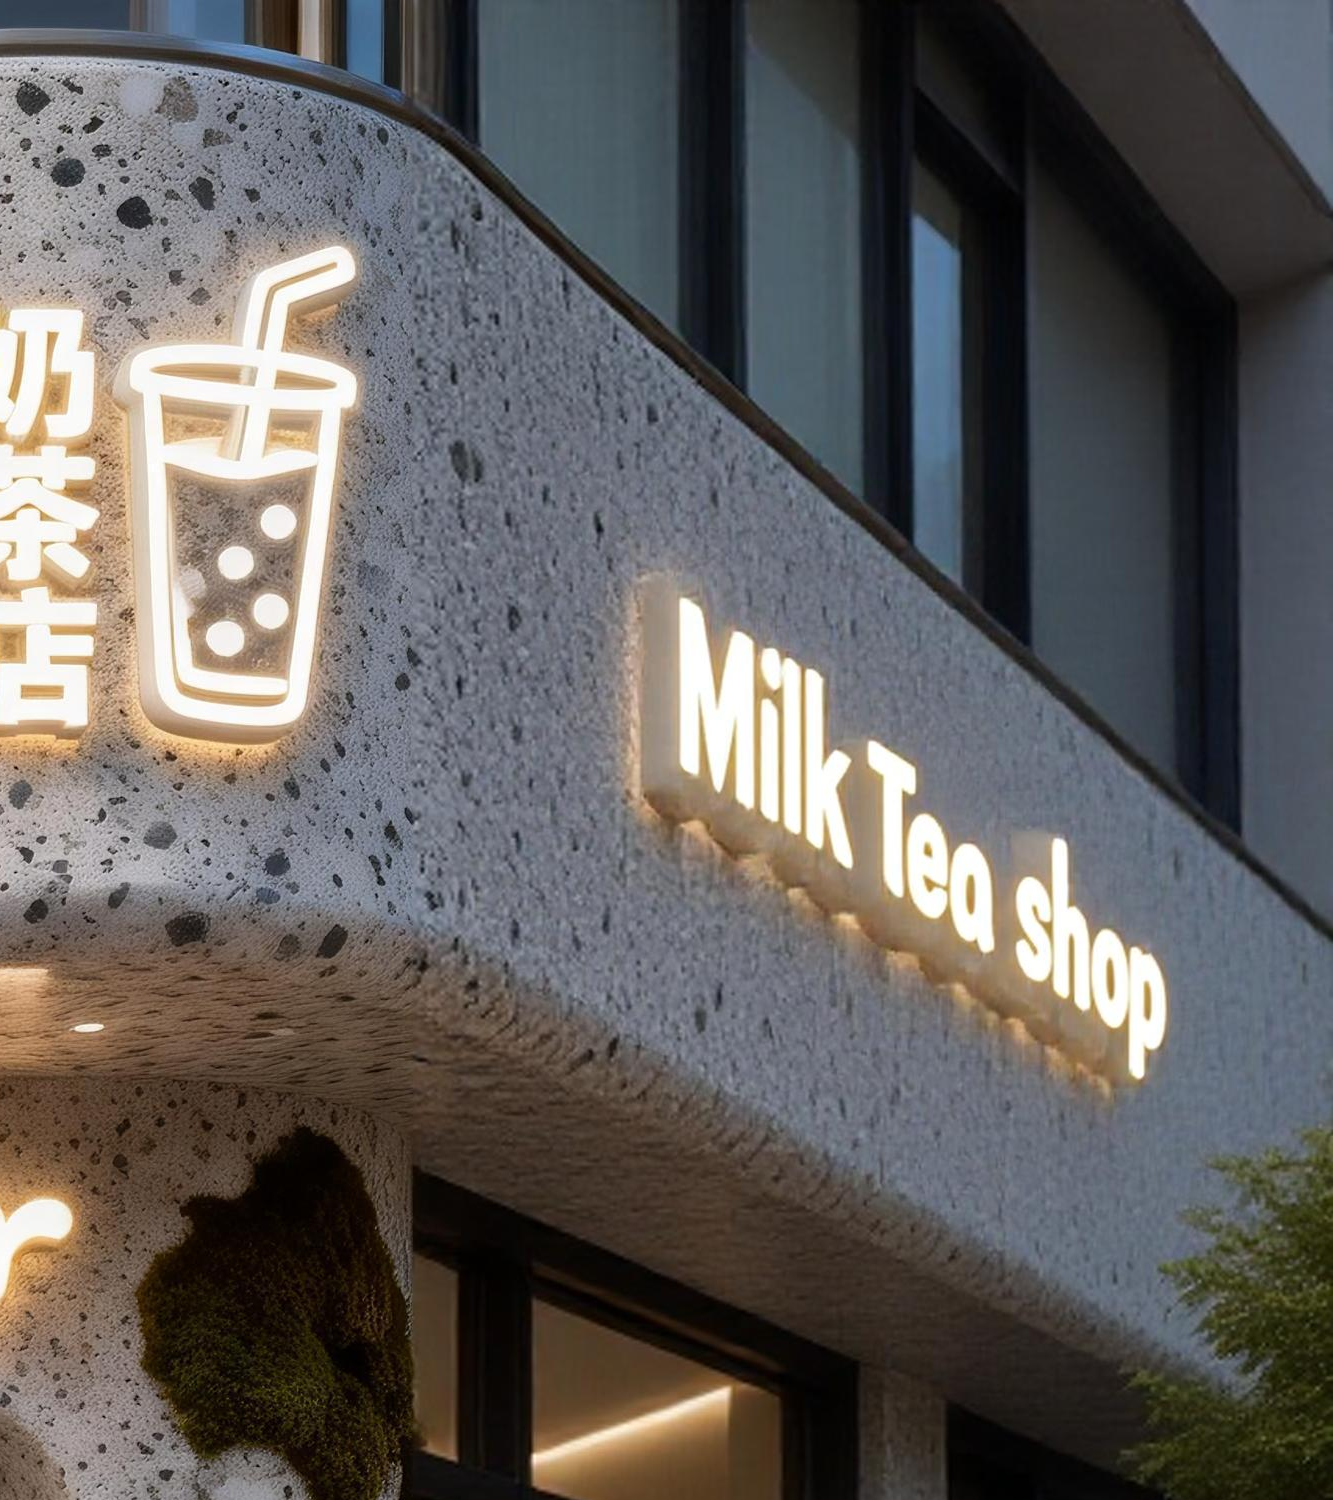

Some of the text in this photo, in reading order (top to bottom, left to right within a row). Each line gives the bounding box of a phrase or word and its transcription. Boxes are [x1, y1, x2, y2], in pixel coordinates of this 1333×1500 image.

[678, 597, 1166, 1079] Milk Tea shop
